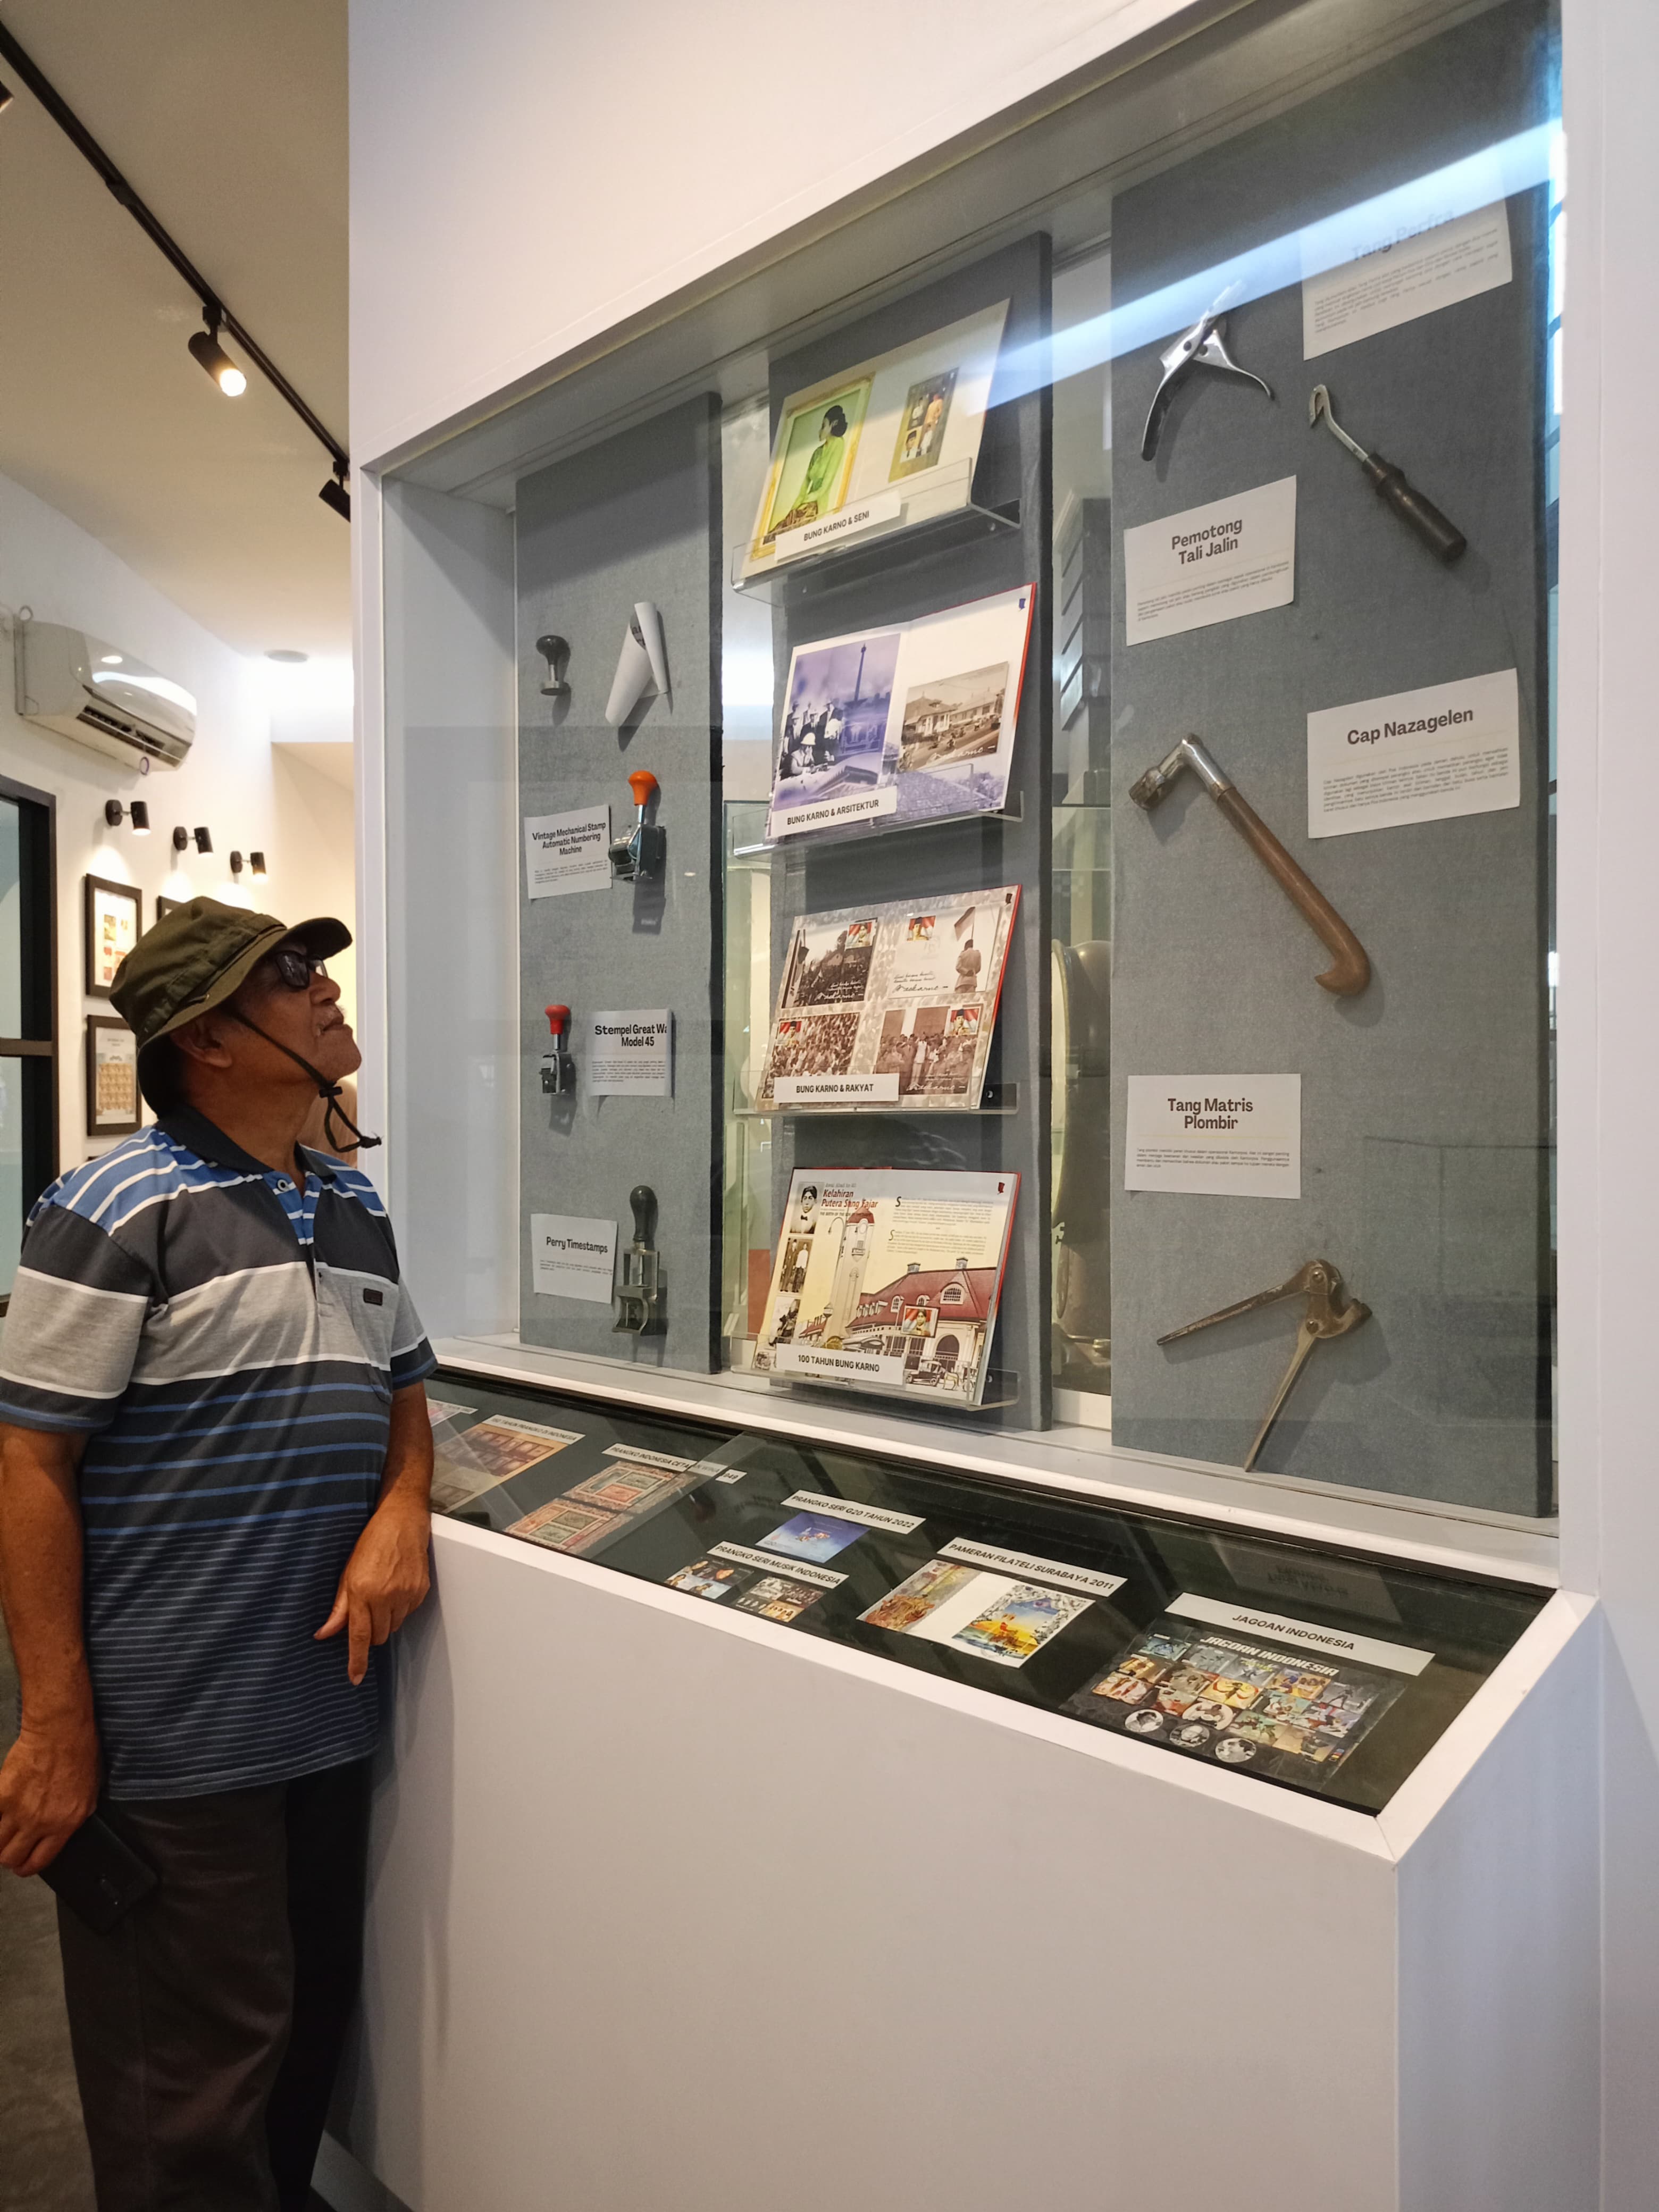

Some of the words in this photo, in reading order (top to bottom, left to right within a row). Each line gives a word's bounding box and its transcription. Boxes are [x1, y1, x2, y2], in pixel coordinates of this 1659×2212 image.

[804, 528, 822, 541] BUNG
[823, 519, 847, 534] KARNO
[848, 517, 852, 525] &
[854, 510, 869, 523] SENI
[1172, 519, 1243, 550] Pemotong
[1178, 545, 1202, 564] Tali
[1206, 537, 1238, 557] Jalin
[1347, 729, 1380, 745] Cap
[1384, 709, 1473, 738] Nazagelen
[787, 815, 805, 825] BUNG
[806, 810, 830, 822] KARNO
[836, 799, 879, 815] ARSITEKTUR
[532, 832, 556, 840] Vintage
[557, 825, 587, 836] Mechanical
[588, 823, 606, 831] Stamp
[542, 837, 570, 849] Automatic
[571, 832, 601, 844] Numbering
[559, 845, 582, 855] Machine
[595, 1024, 631, 1037] Stempel
[633, 1024, 655, 1034] Great
[622, 1036, 643, 1046] Model
[644, 1036, 655, 1046] 45
[1168, 1098, 1201, 1115] Tang
[1204, 1097, 1253, 1111] Matris
[1184, 1115, 1238, 1129] Plombir
[823, 1188, 854, 1197] Kelahiran
[821, 1199, 842, 1207] Putera
[844, 1199, 860, 1210] Sang
[861, 1199, 878, 1210] Fajar
[547, 1236, 566, 1250] Perry
[567, 1238, 608, 1255] Timestamps
[798, 1354, 810, 1363] 100
[811, 1356, 834, 1366] TAHUN
[835, 1359, 854, 1369] BUNG
[856, 1361, 880, 1372] KARNO
[611, 1446, 640, 1456] PRANGKO
[639, 1454, 673, 1464] INDONESIA
[792, 1496, 828, 1507] PRANGKO
[864, 1512, 893, 1523] TAHUN
[892, 1519, 915, 1528] 2022
[715, 1546, 753, 1559] PRANGKO
[752, 1555, 770, 1564] SERI
[769, 1561, 797, 1571] MUSIK
[795, 1566, 841, 1584] INDONESIA
[948, 1544, 995, 1560] PAMERAN
[993, 1555, 1034, 1569] FILATELI
[1034, 1565, 1090, 1583] SURABAYA
[1089, 1579, 1115, 1589] 2011
[1232, 1615, 1286, 1632] JAGOAN
[1285, 1627, 1355, 1650] INDONESIA
[1200, 1637, 1262, 1656] JAGOAN
[1258, 1650, 1339, 1676] INDONESIA
